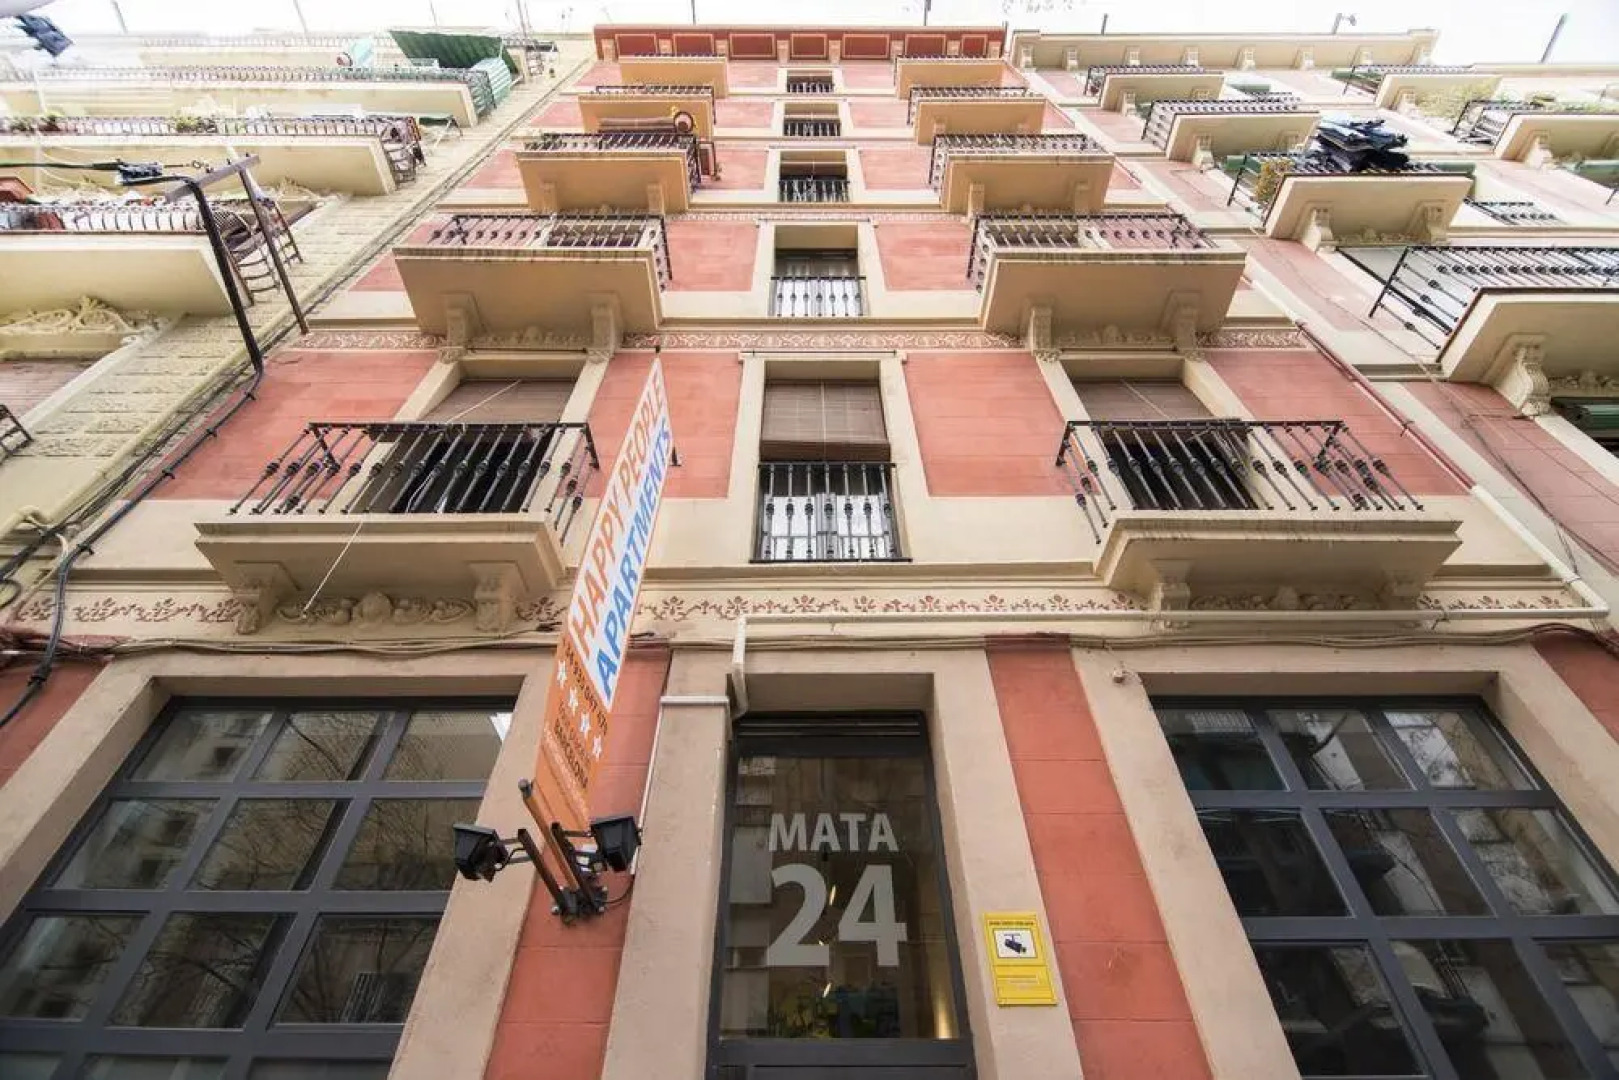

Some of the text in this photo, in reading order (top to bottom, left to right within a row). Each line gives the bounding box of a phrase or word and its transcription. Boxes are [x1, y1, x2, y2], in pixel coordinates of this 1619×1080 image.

[572, 483, 625, 660] HAPPY
[620, 370, 663, 506] PEOPLE
[597, 417, 670, 700] APARTMENTS
[766, 863, 908, 966] 24
[769, 813, 899, 852] MATA
